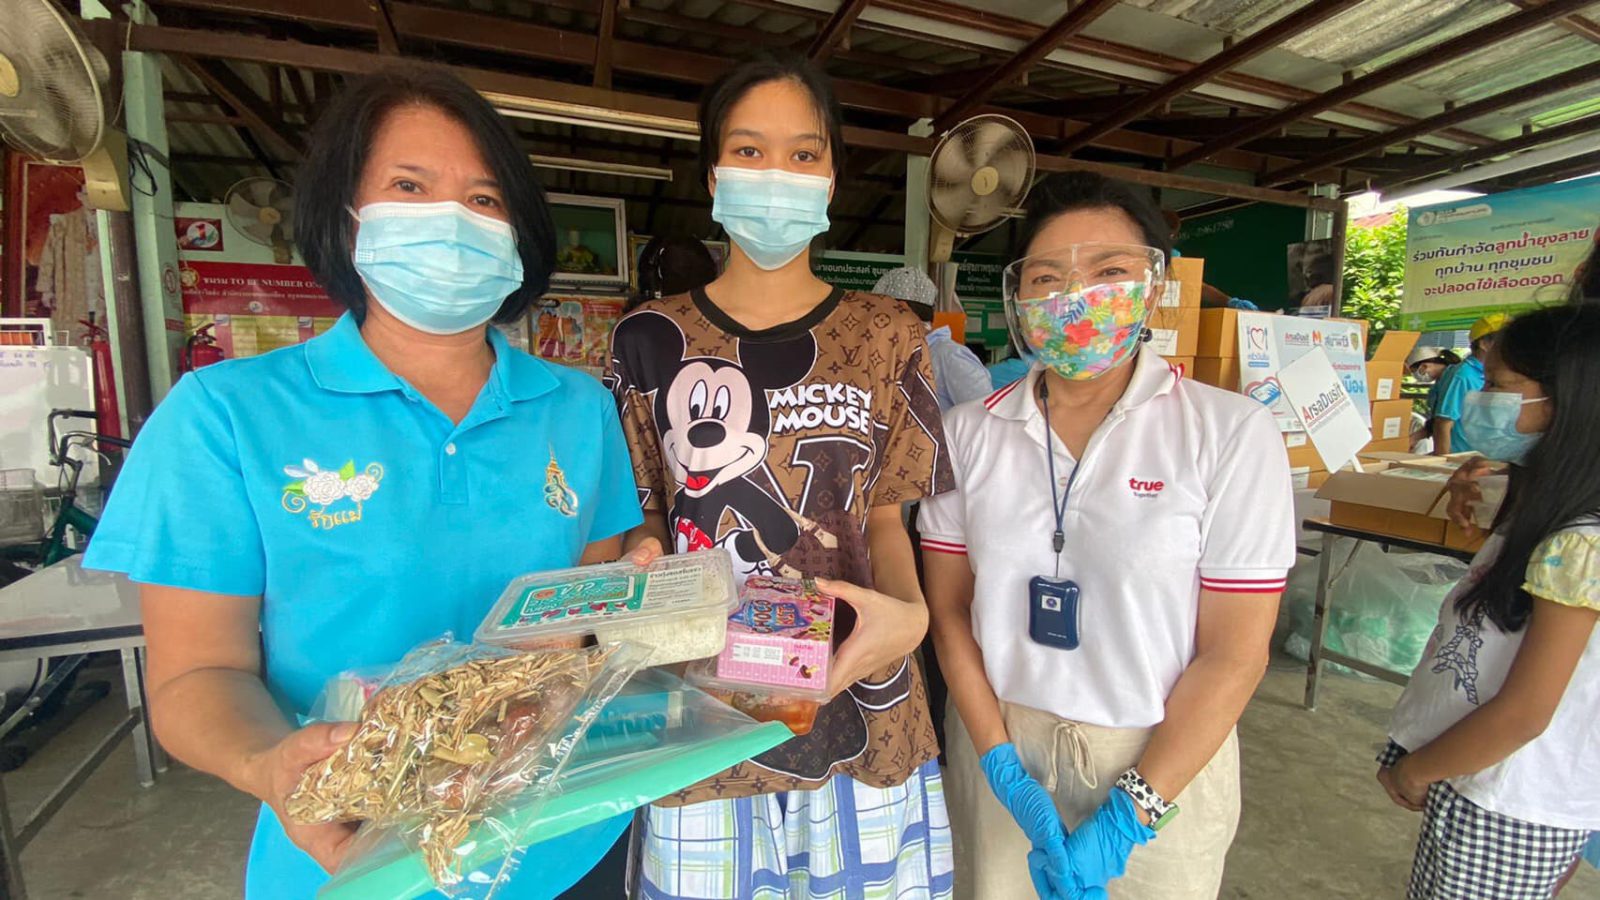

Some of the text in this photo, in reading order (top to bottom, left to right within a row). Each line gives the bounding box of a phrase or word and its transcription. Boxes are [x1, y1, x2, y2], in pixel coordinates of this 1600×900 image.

[1435, 255, 1553, 279] ทุกบ้าน ทุกชุมชน
[262, 279, 303, 288] NUMBER
[770, 382, 872, 410] MICKEY
[1302, 383, 1344, 423] ArsaDusit
[774, 406, 870, 432] MOUSE
[1129, 478, 1164, 491] true
[752, 599, 773, 633] CHOCO
